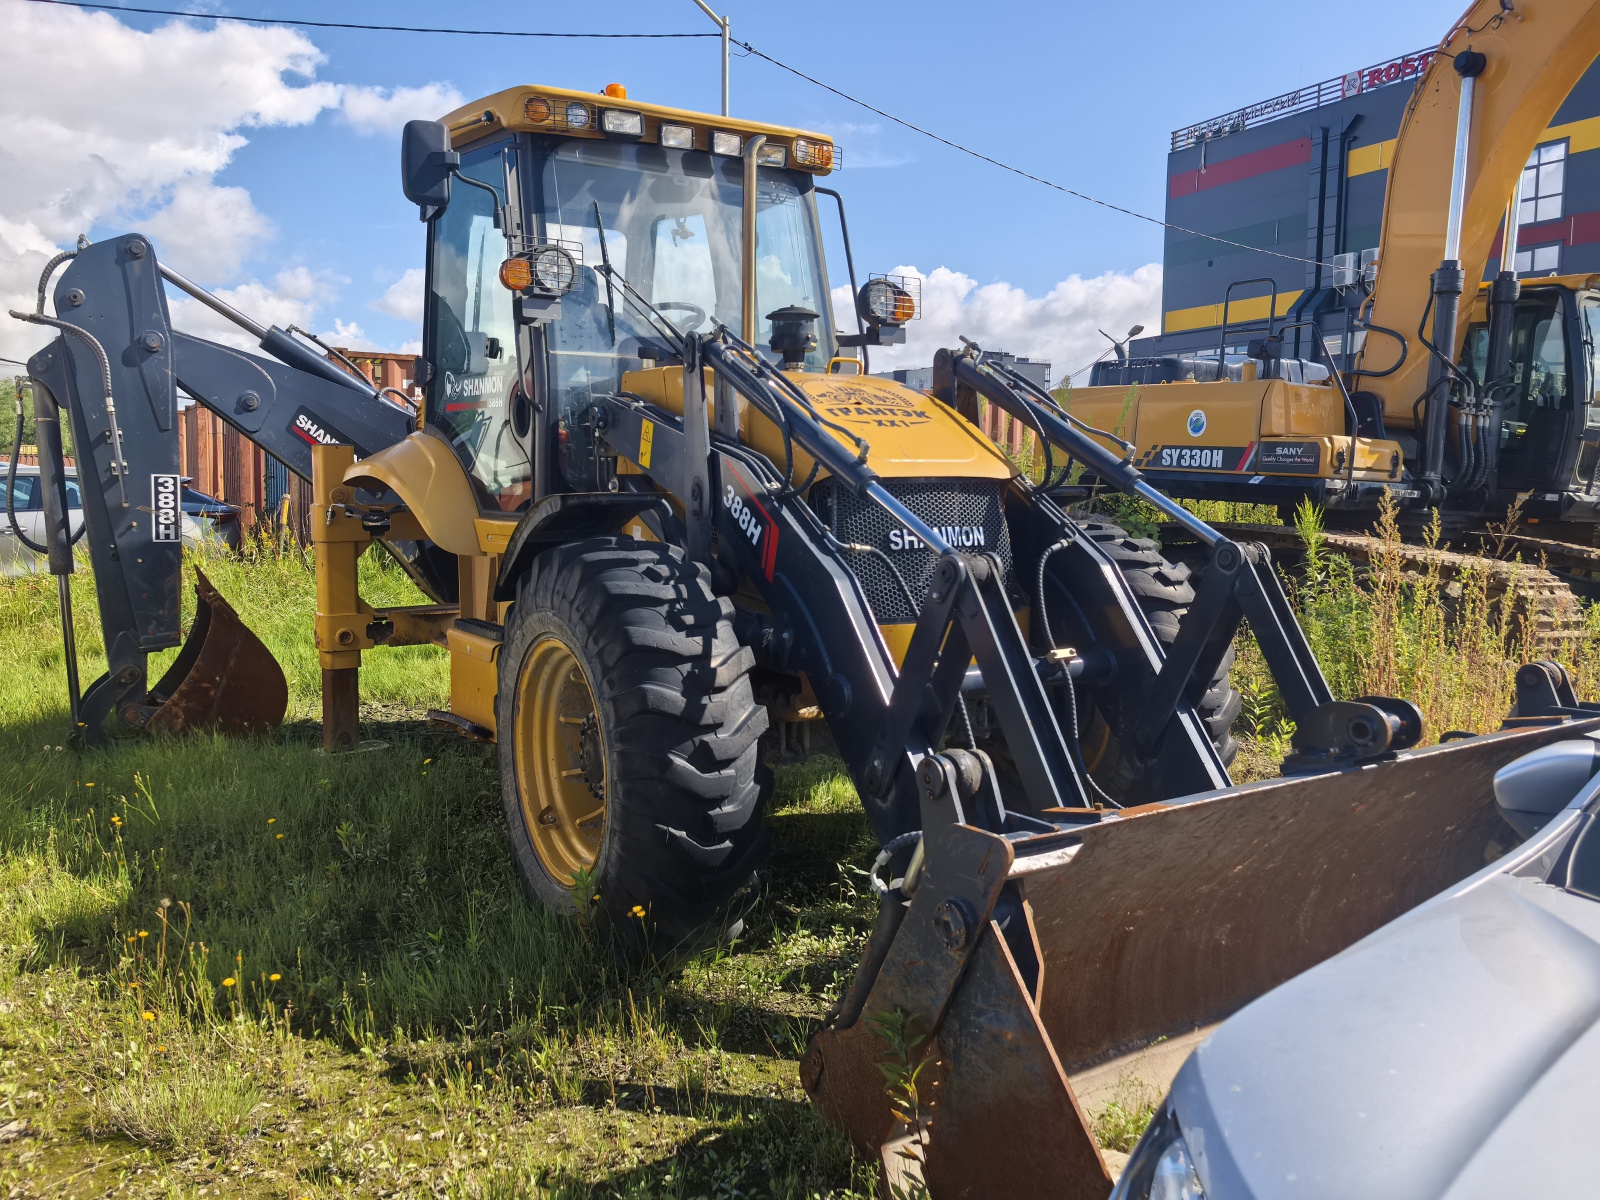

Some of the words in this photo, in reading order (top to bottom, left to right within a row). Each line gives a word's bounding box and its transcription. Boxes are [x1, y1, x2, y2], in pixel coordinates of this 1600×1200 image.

[463, 375, 503, 397] SHANMON
[825, 407, 933, 419] ГРАНТЭК
[296, 414, 341, 444] SHAN
[1161, 447, 1223, 468] SY330H
[1275, 446, 1304, 455] SANY
[157, 477, 176, 540] 388H
[723, 484, 762, 546] 388H
[889, 526, 985, 551] SHNMON
